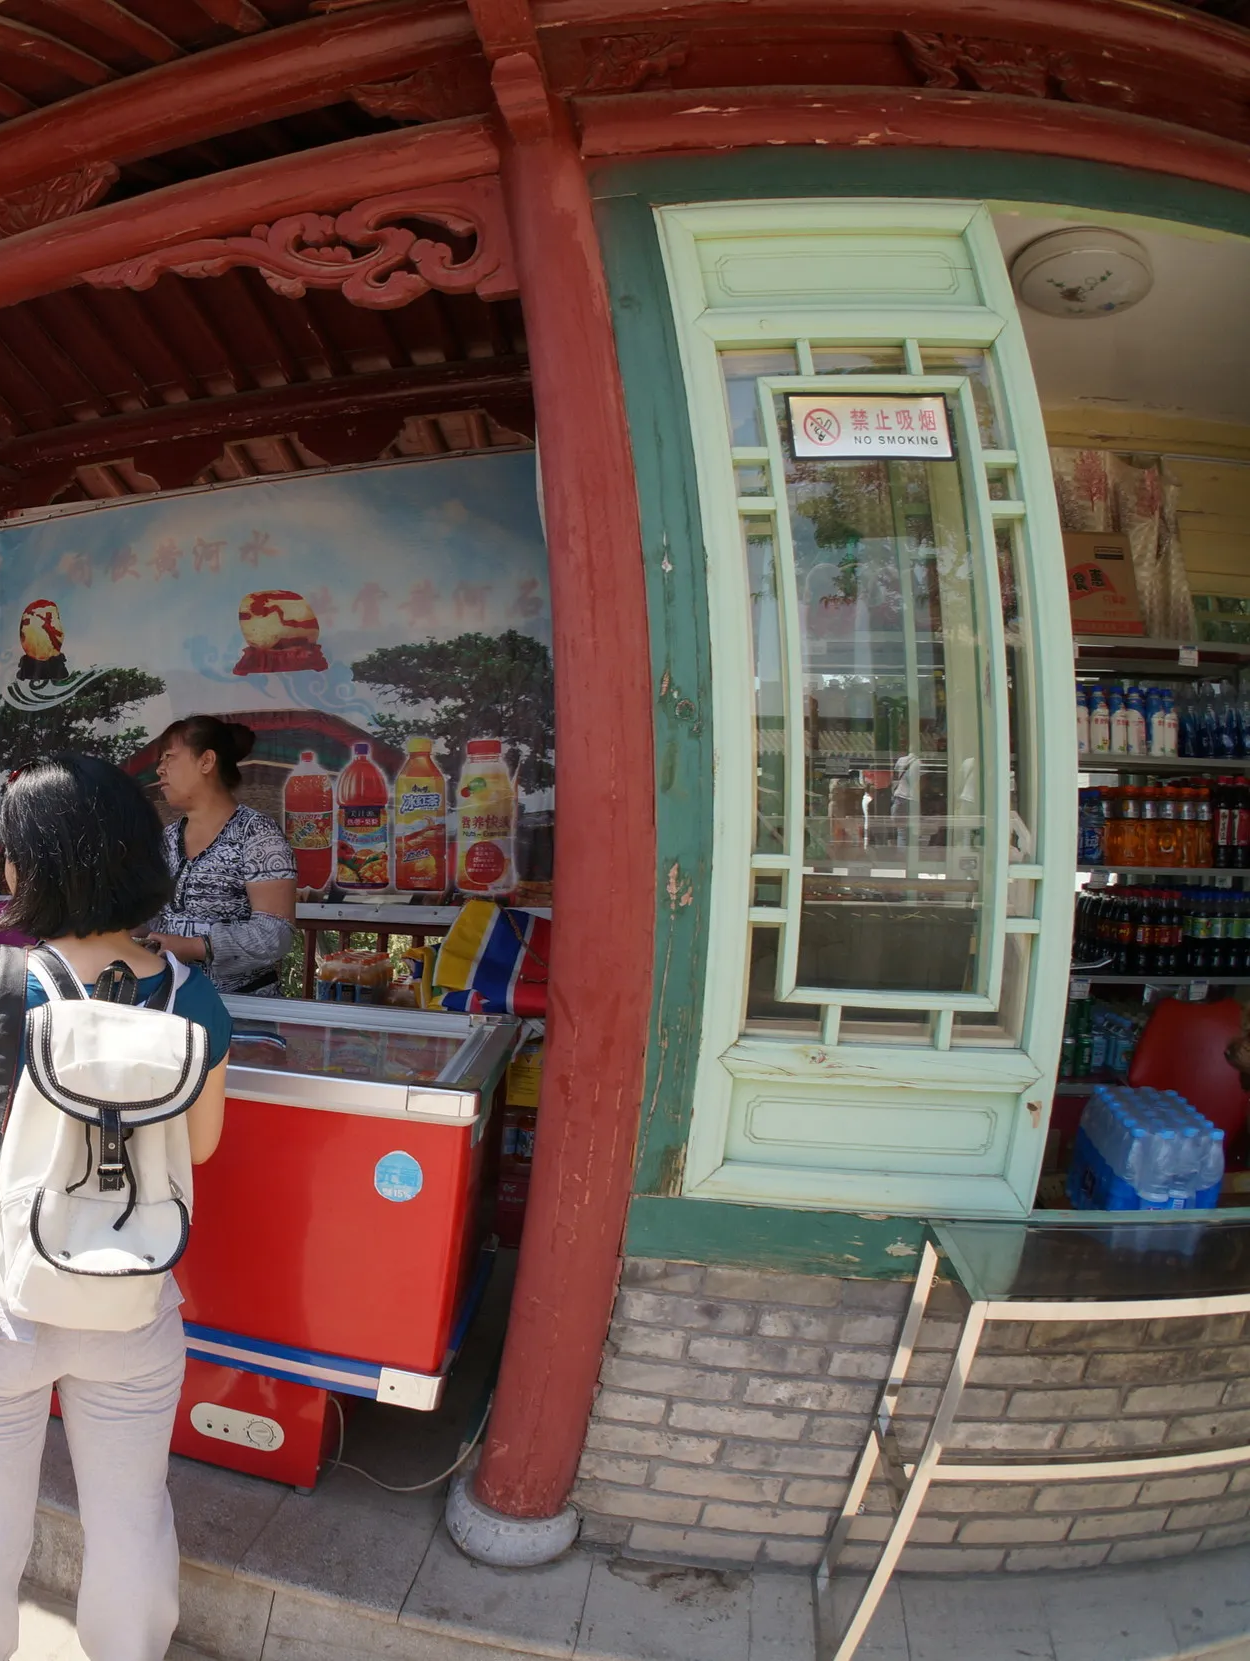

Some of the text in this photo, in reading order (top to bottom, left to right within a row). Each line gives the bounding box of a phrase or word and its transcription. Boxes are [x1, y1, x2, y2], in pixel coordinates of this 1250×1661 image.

[850, 408, 937, 431] 禁止吸烟
[854, 435, 939, 445] NO SMOKING
